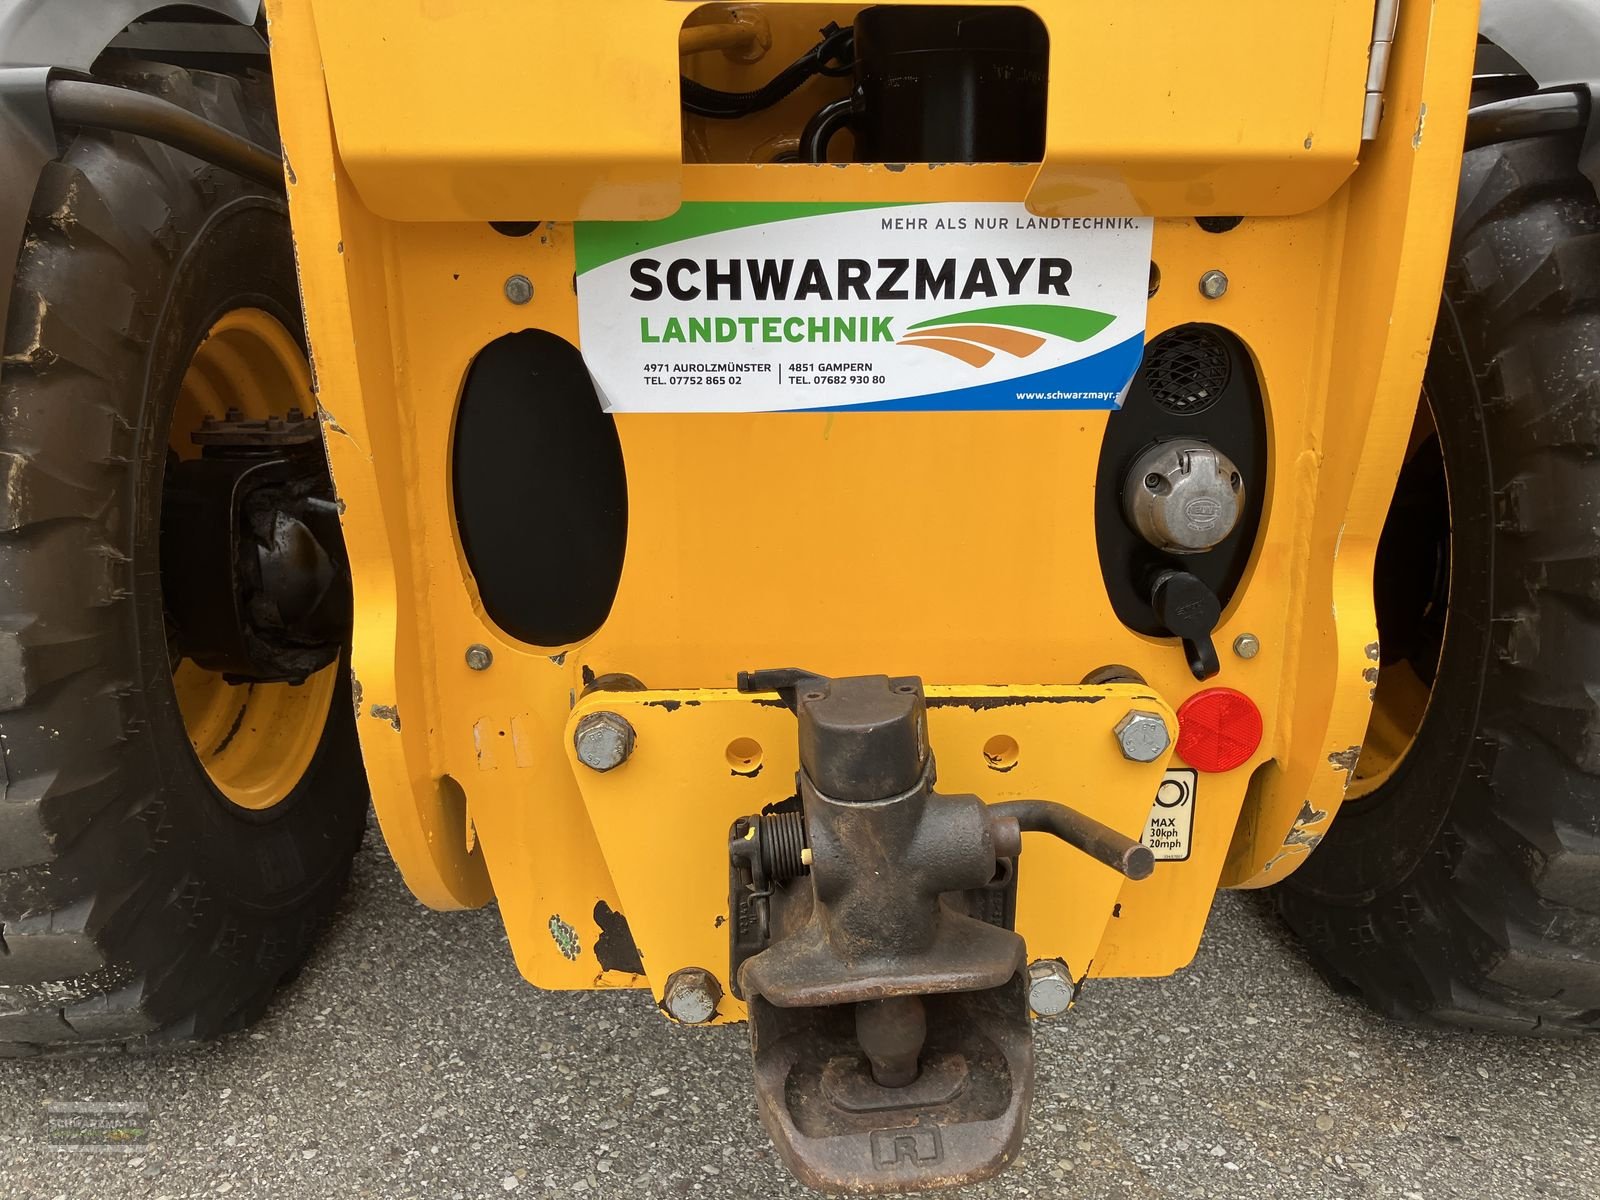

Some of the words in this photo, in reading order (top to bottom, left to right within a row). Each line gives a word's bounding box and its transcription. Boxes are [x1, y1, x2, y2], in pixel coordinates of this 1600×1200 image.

[882, 217, 927, 229] MEHR
[936, 217, 967, 229] ALS
[975, 217, 1009, 229] NUR
[1016, 217, 1139, 229] LANDTECHNIK.
[629, 258, 1073, 301] SCHWARZMAYR
[641, 316, 894, 343] LANDTECHNIK
[643, 363, 669, 373] 4971
[673, 361, 772, 373] AUROLZMÜNSTER
[788, 363, 814, 372] 4851
[818, 363, 873, 372] GAMPERN
[643, 376, 667, 385] TEL.
[669, 376, 703, 385] 07752
[705, 376, 726, 385] 865
[729, 376, 742, 385] 02
[788, 376, 811, 385] TEL.
[813, 376, 847, 385] 07682
[849, 375, 870, 384] 930
[872, 375, 886, 384] 80
[1150, 818, 1176, 828] MAX
[1150, 828, 1178, 839] 30kph
[1149, 839, 1181, 850] 20mph
